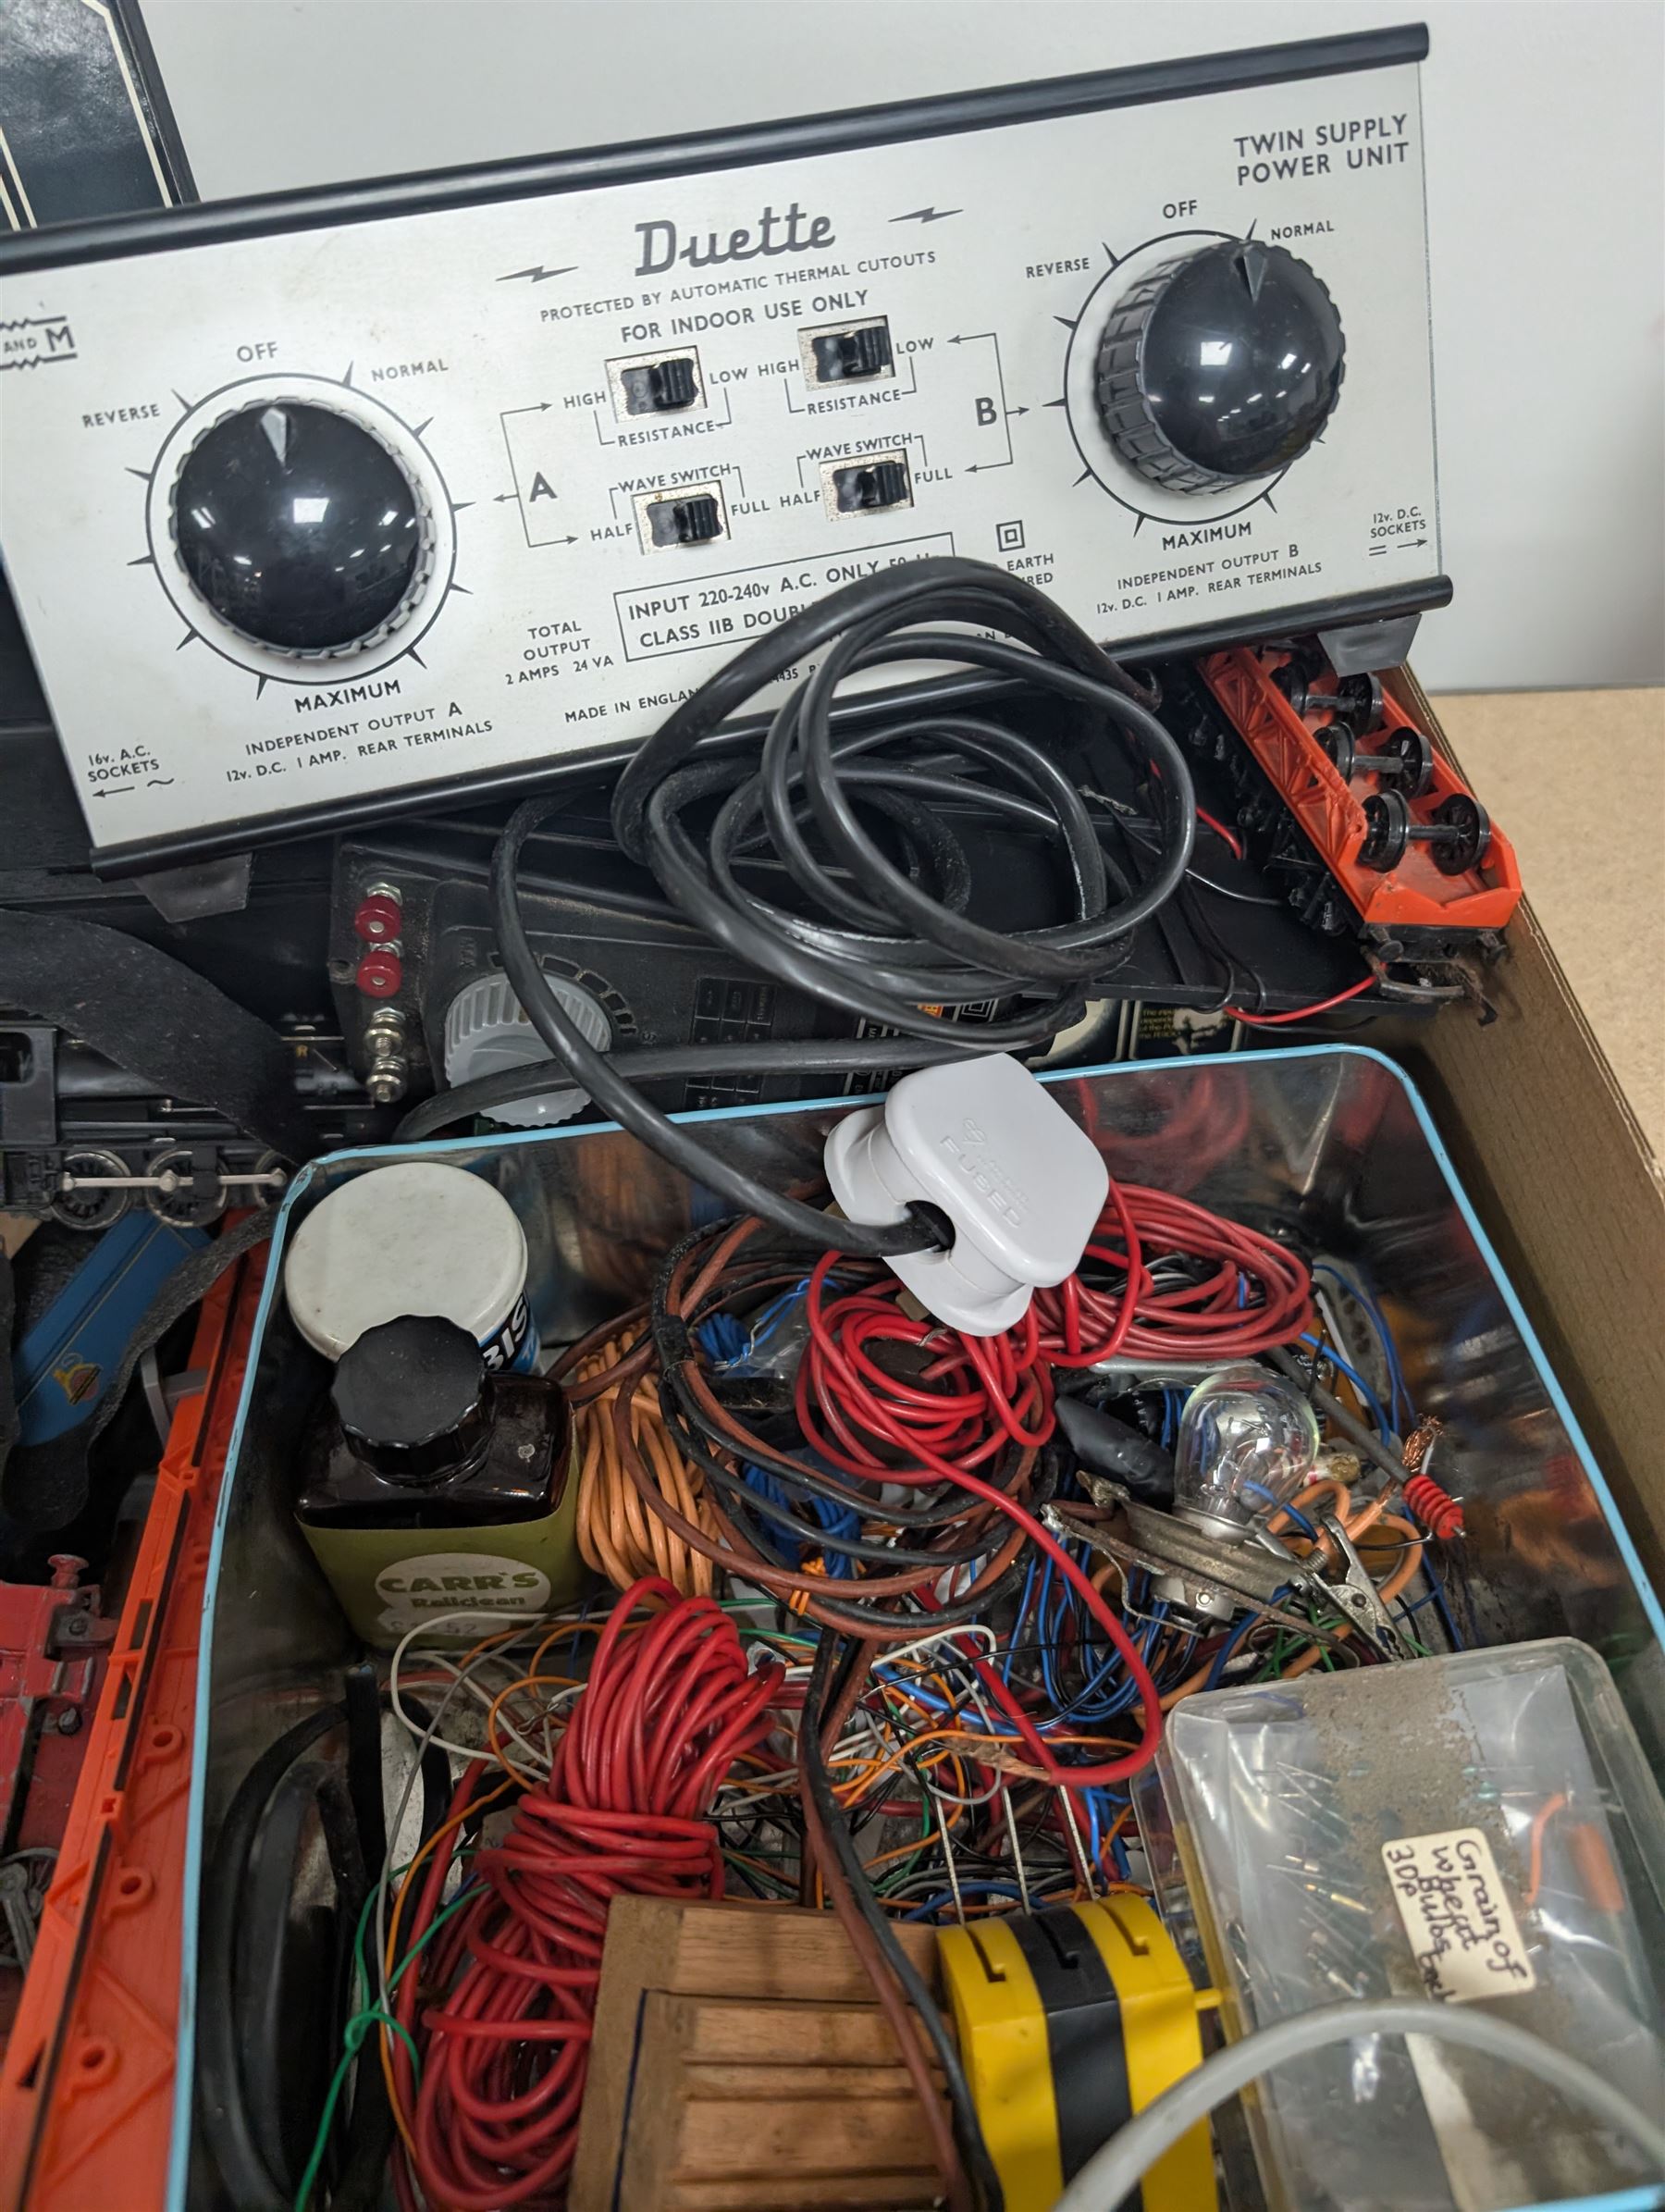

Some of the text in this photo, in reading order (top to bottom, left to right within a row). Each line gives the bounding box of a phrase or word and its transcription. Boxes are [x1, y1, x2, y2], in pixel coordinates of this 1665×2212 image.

[1234, 115, 1408, 157] TWIN SUPPLY
[1238, 142, 1410, 185] POWER UNIT
[1163, 200, 1198, 219] OFF
[635, 202, 836, 277] Duette
[1271, 220, 1335, 241] NORMAL
[1026, 257, 1091, 278] REVERSE
[540, 250, 937, 323] PROTECTED BY AUTOMATIC THERMAL CUTOUTS
[622, 290, 869, 343] FOR INDOOR USE ONLY
[5, 326, 75, 353] AND M
[237, 341, 278, 363] OFF
[895, 337, 934, 355] LOW
[372, 359, 449, 382] NORMAL
[709, 367, 748, 386] LOW
[758, 359, 800, 377] HIGH
[563, 390, 607, 409] HIGH
[807, 389, 902, 416] RESISTANCE
[975, 397, 998, 426] B
[82, 404, 161, 427] REVERSE
[618, 420, 716, 448] RESISTANCE
[806, 433, 913, 462] WAVE SWITCH
[528, 471, 557, 502] A
[617, 463, 732, 494] WAVE SWITCH
[914, 468, 953, 485] FULL
[731, 500, 771, 517] FULL
[779, 489, 821, 508] HALF
[1397, 506, 1422, 519] D.C.
[590, 523, 634, 542] HALF
[1163, 523, 1252, 550] MAXIMUM
[1370, 519, 1425, 538] SOCKETS
[1006, 553, 1054, 571] EARTH
[1117, 544, 1299, 589] INDEPENDENT OUTPUT B
[628, 594, 691, 622] INPUT
[698, 582, 771, 609] 220-240v
[780, 573, 818, 594] A.C.
[826, 561, 880, 584] ONLY
[1122, 596, 1147, 611] D.C.
[1166, 586, 1199, 602] AMP.
[1208, 577, 1241, 592] REAR
[1247, 562, 1322, 586] TERMINALS
[527, 621, 582, 639] TOTAL
[639, 624, 700, 649] CLASS
[523, 638, 591, 661] OUTPUT
[505, 655, 614, 686] 2 AMPS 24 VA
[295, 680, 401, 713] MAXIMUM
[564, 687, 699, 723] MADE IN ENGLAN
[246, 701, 462, 755] INDEPENDENT OUTPUT A
[89, 746, 151, 766] 16v. A.C.
[256, 760, 287, 777] D.C.
[309, 749, 347, 769] AMP.
[358, 739, 398, 758] REAR
[403, 720, 493, 748] TERMINALS
[88, 759, 160, 782] SOCKETS
[940, 1135, 1022, 1229] FUSED
[378, 1572, 540, 1593] CARR'S
[1456, 1839, 1528, 1979] Grain of
